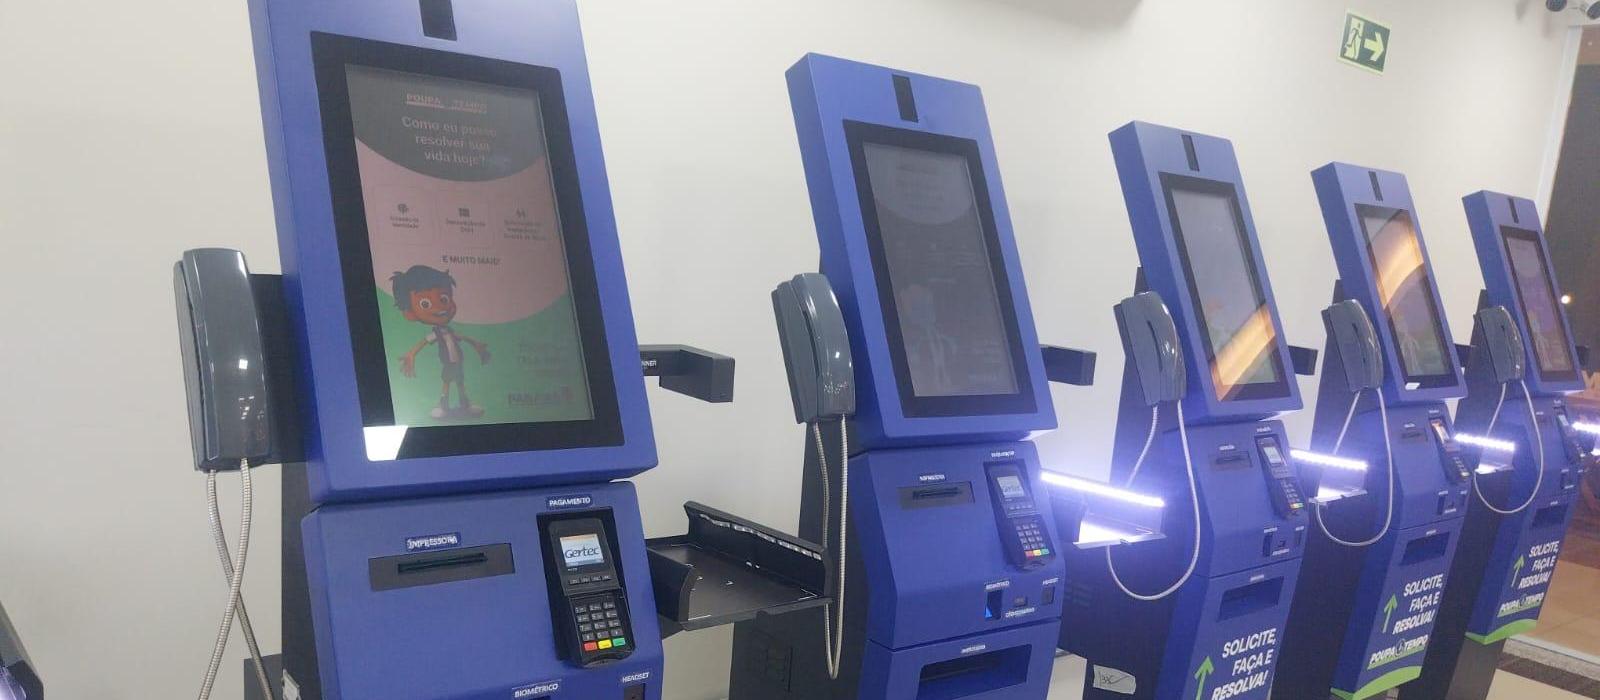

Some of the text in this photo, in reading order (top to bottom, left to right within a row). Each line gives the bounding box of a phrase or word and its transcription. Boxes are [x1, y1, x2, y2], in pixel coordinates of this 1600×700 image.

[401, 116, 440, 129] Como
[443, 123, 458, 133] eu
[415, 135, 464, 147] resolver
[424, 151, 450, 163] vida
[450, 256, 477, 265] MUITO
[549, 496, 591, 507] PAGAMENTO
[407, 535, 459, 549] IMPRESSORA
[1403, 573, 1444, 597] SOLICITE,
[1409, 591, 1441, 613] FAÇA E
[1392, 609, 1436, 635] RESOLVA!
[1222, 628, 1277, 658] SOLICITE,
[1232, 649, 1274, 676] FAÇA E
[622, 672, 650, 683] HEADSET
[1211, 670, 1269, 700] RESOLVA!
[514, 683, 559, 698] BIOMÉTRICO
